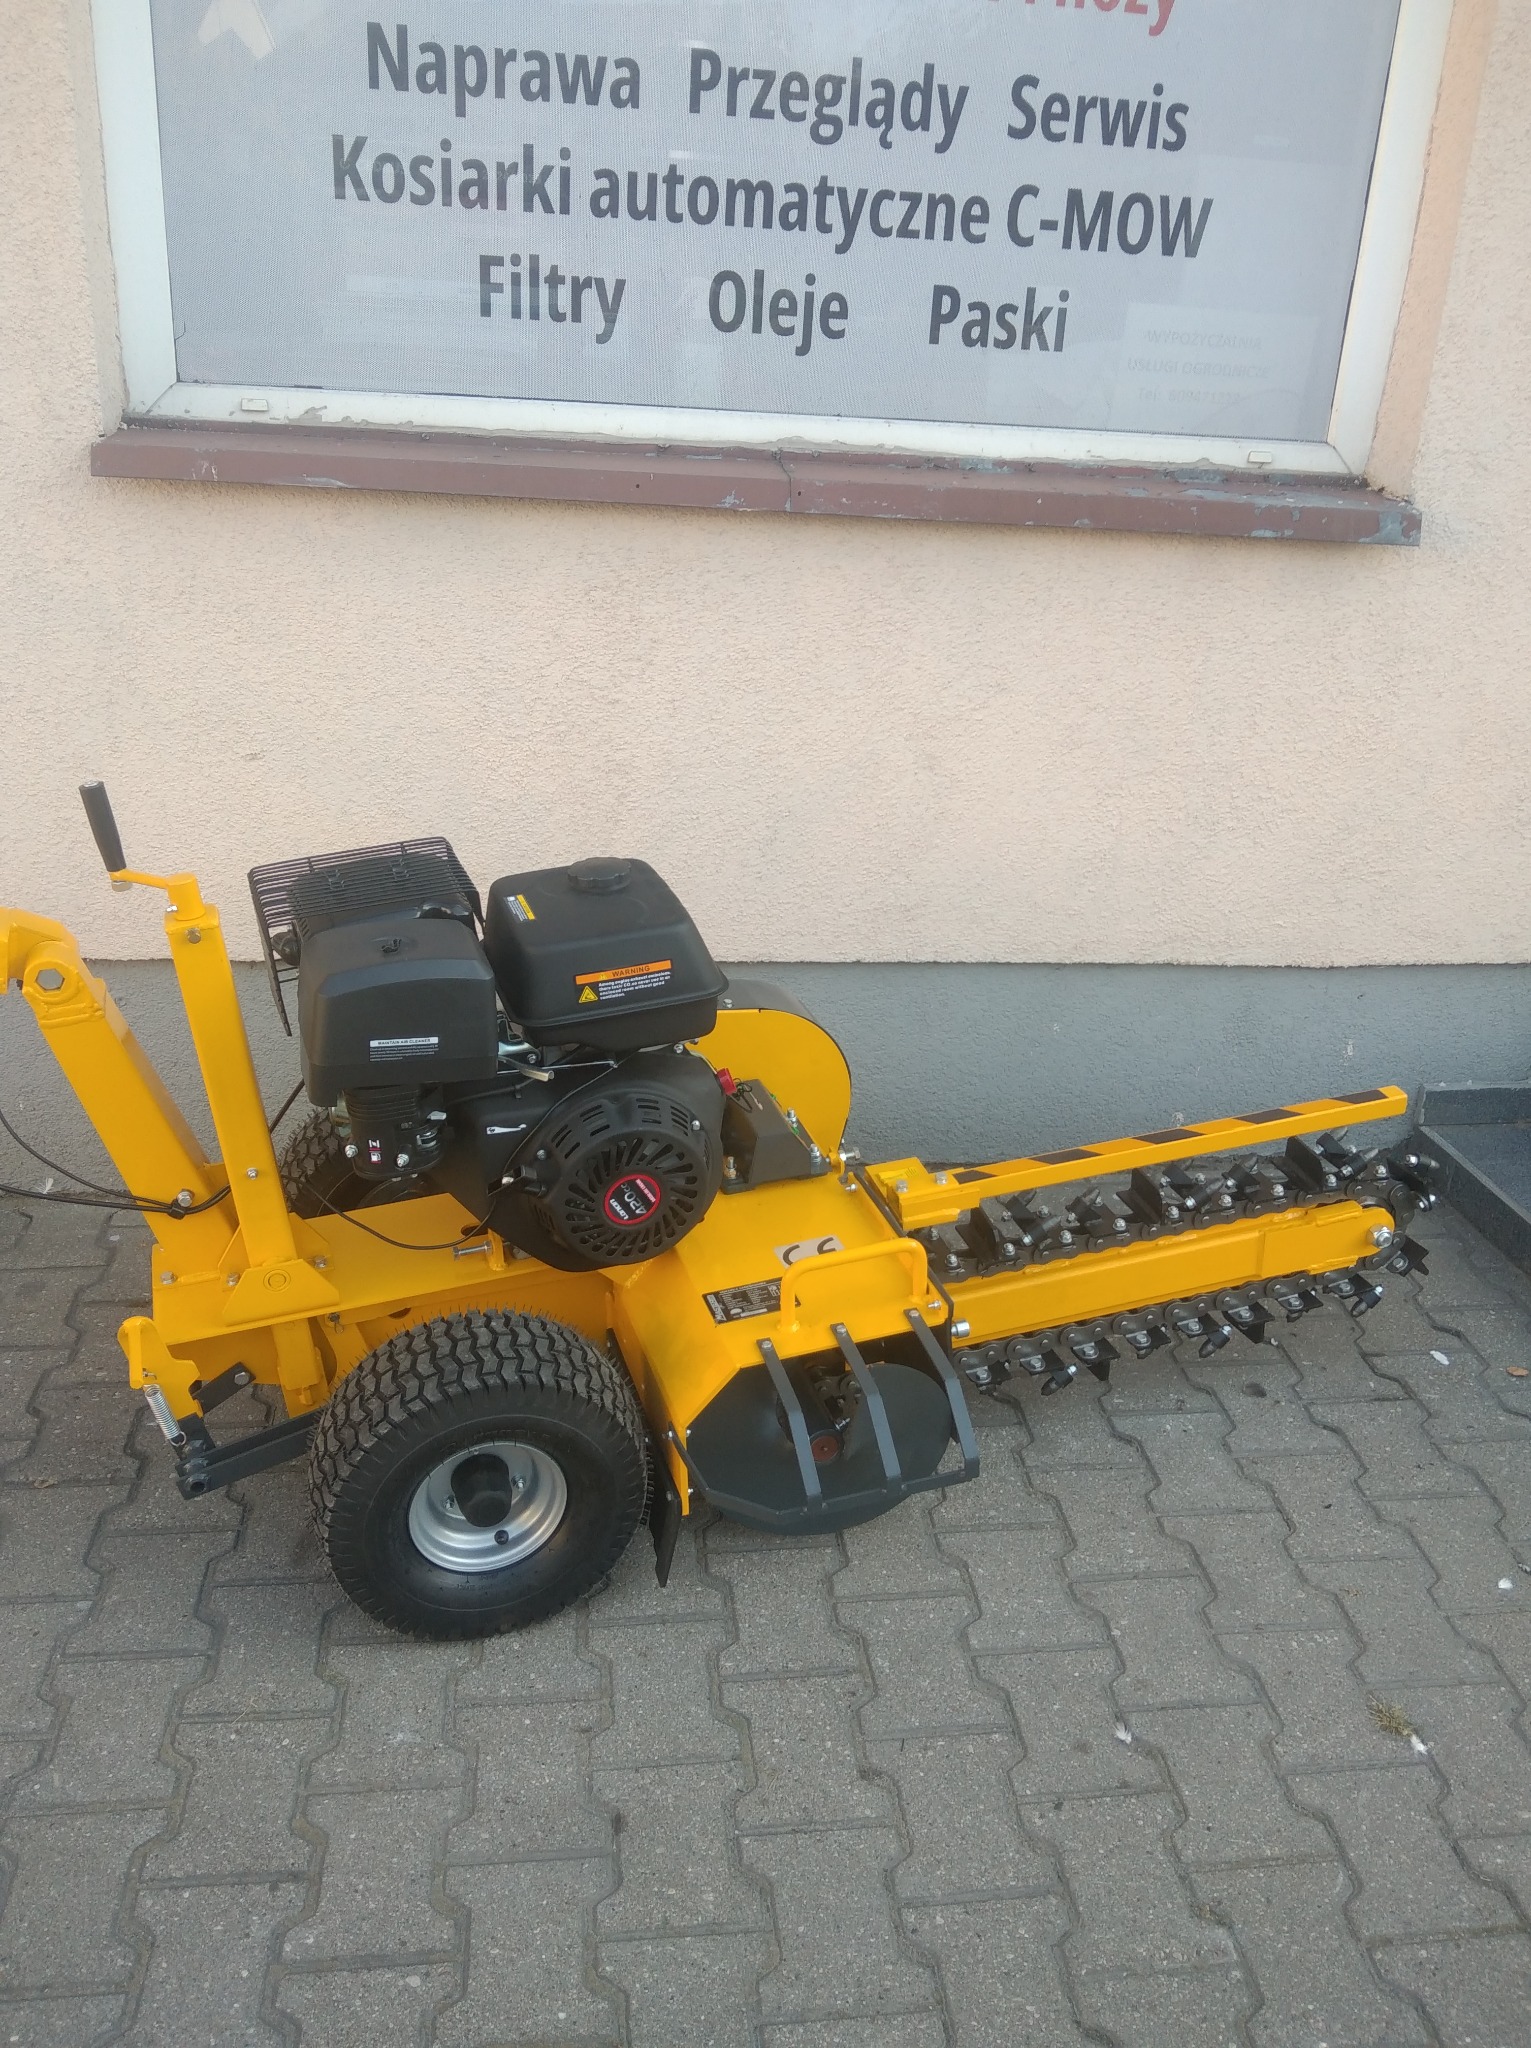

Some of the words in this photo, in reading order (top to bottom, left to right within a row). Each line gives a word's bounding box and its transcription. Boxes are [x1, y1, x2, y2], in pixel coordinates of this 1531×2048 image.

[367, 22, 640, 117] Naprawa
[690, 48, 968, 153] Przeglądy
[1008, 75, 1188, 151] Serwis
[332, 134, 571, 215] Kosiarki
[590, 164, 990, 255] automatyczne
[1008, 184, 1213, 258] C-MOW
[479, 253, 626, 344] Filtry
[709, 269, 849, 357] Oleje
[929, 284, 1069, 352] Paski
[612, 966, 650, 977] WARNING
[620, 1182, 647, 1214] 420cc
